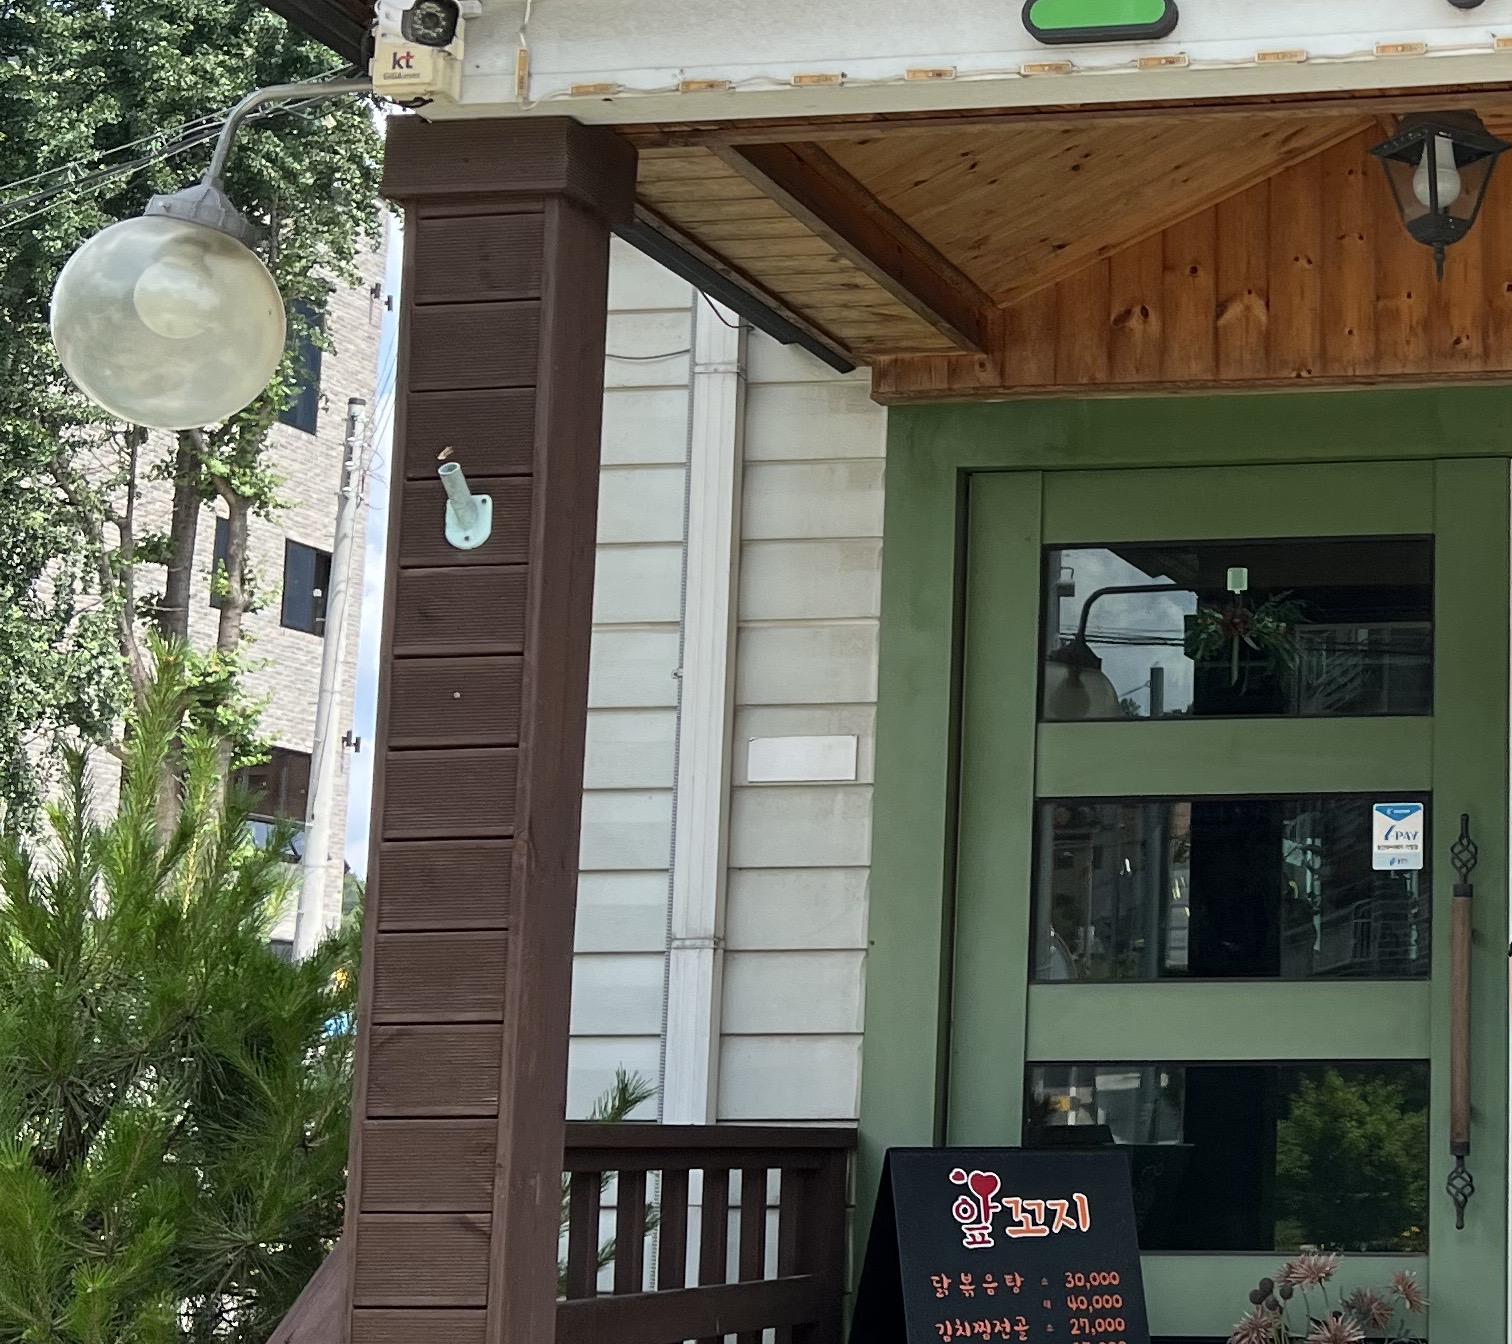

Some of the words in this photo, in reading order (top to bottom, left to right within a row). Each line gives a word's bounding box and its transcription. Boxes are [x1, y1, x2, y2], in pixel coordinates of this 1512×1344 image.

[392, 51, 415, 69] kt
[949, 1168, 1091, 1248] 앞꼬지
[1064, 1271, 1121, 1290] 30,000
[1066, 1294, 1123, 1313] 40,000
[935, 1316, 1030, 1343] 김치찜전골
[1070, 1317, 1126, 1336] 27,000
